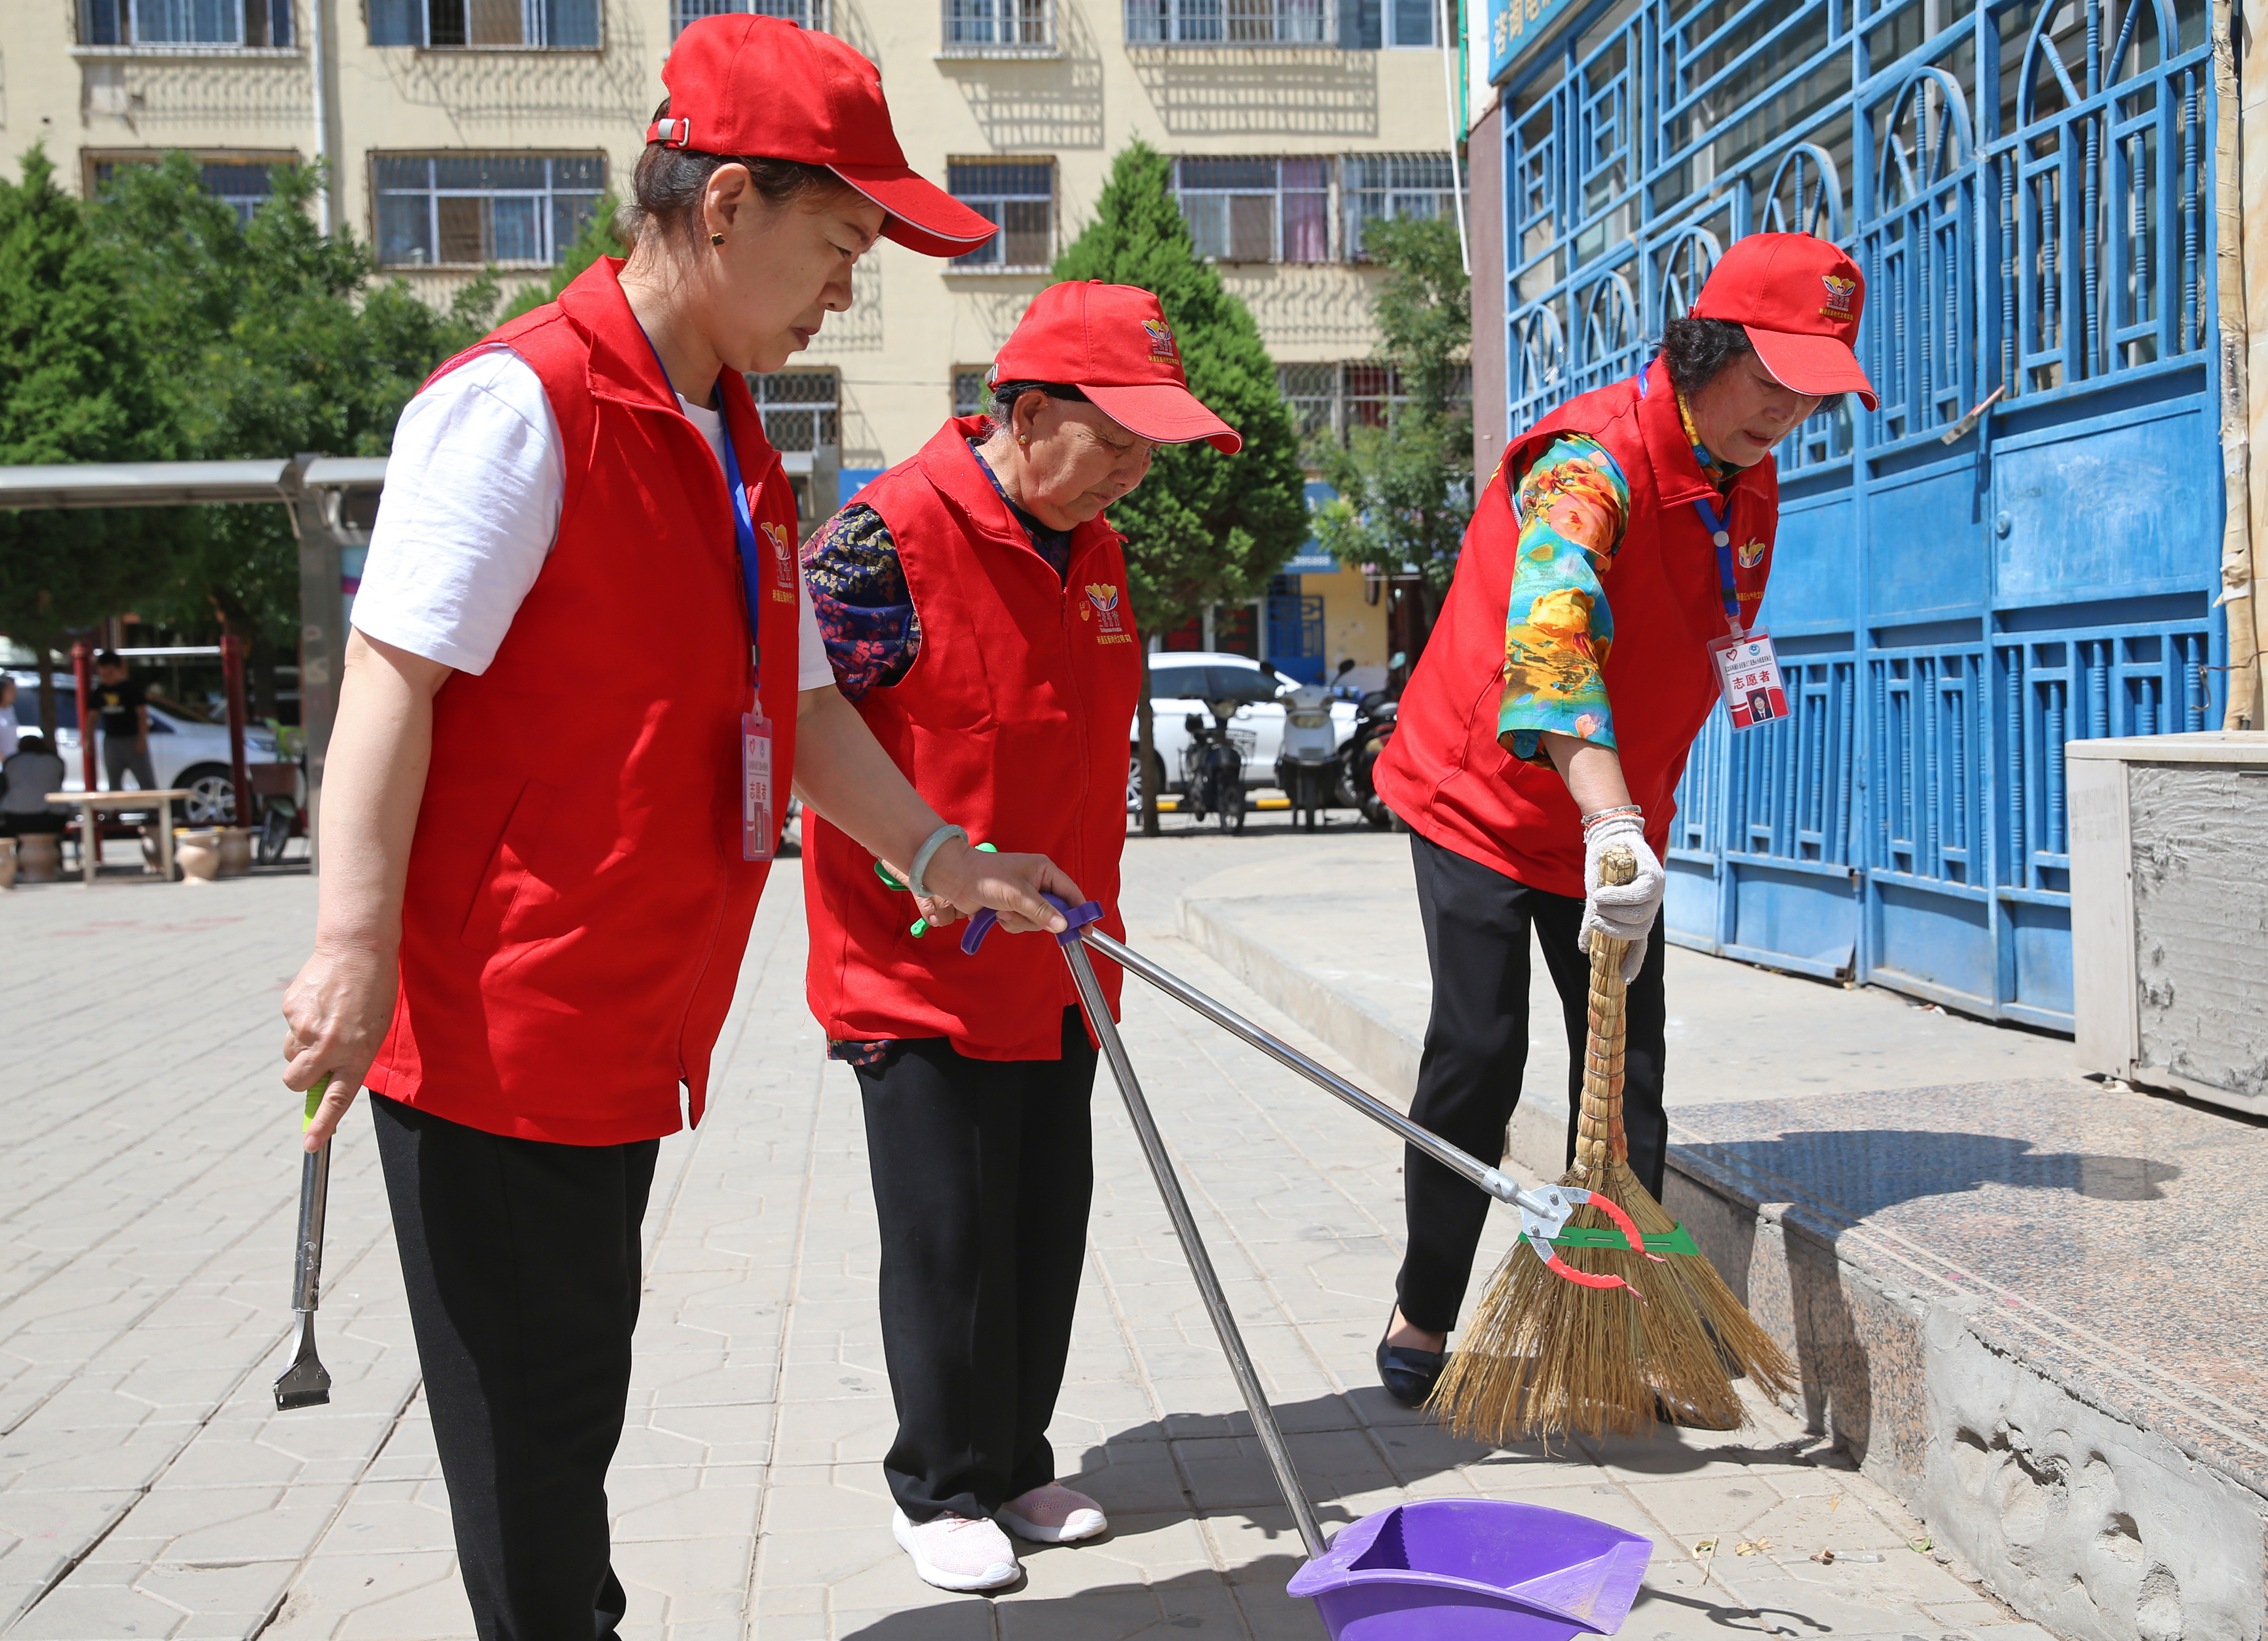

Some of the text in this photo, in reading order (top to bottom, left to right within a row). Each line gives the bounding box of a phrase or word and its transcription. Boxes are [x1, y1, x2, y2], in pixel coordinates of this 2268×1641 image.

[1733, 670, 1770, 690] 志愿者
[750, 781, 767, 800] 志愿者
